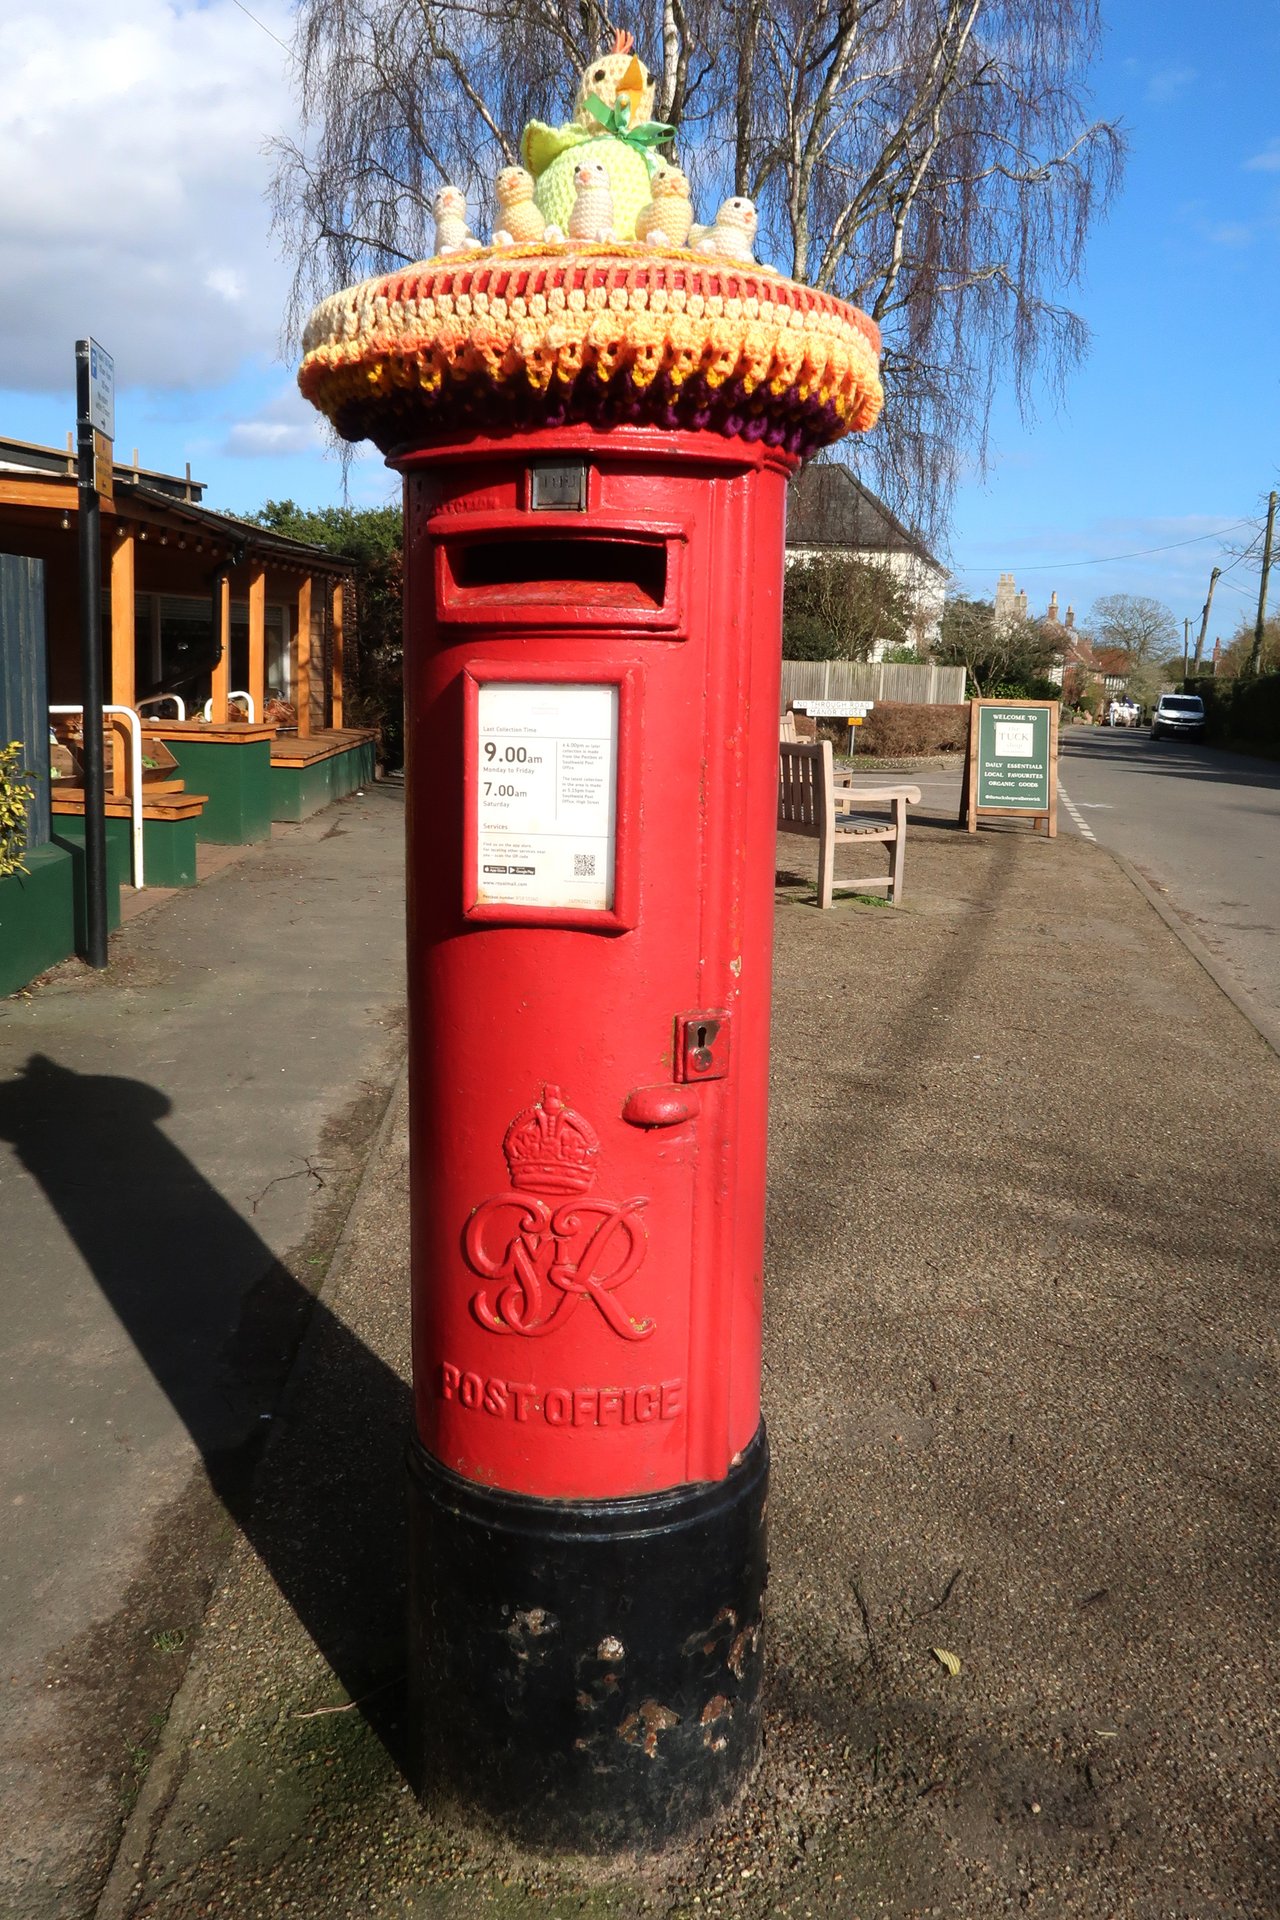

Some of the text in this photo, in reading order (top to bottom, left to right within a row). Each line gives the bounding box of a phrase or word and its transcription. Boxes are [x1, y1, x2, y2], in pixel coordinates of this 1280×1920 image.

[810, 701, 847, 709] THROUGH
[999, 732, 1029, 741] TUCK
[484, 742, 543, 763] 9.00am
[484, 782, 527, 797] 7.00am
[443, 1361, 682, 1427] POST OFFICE
